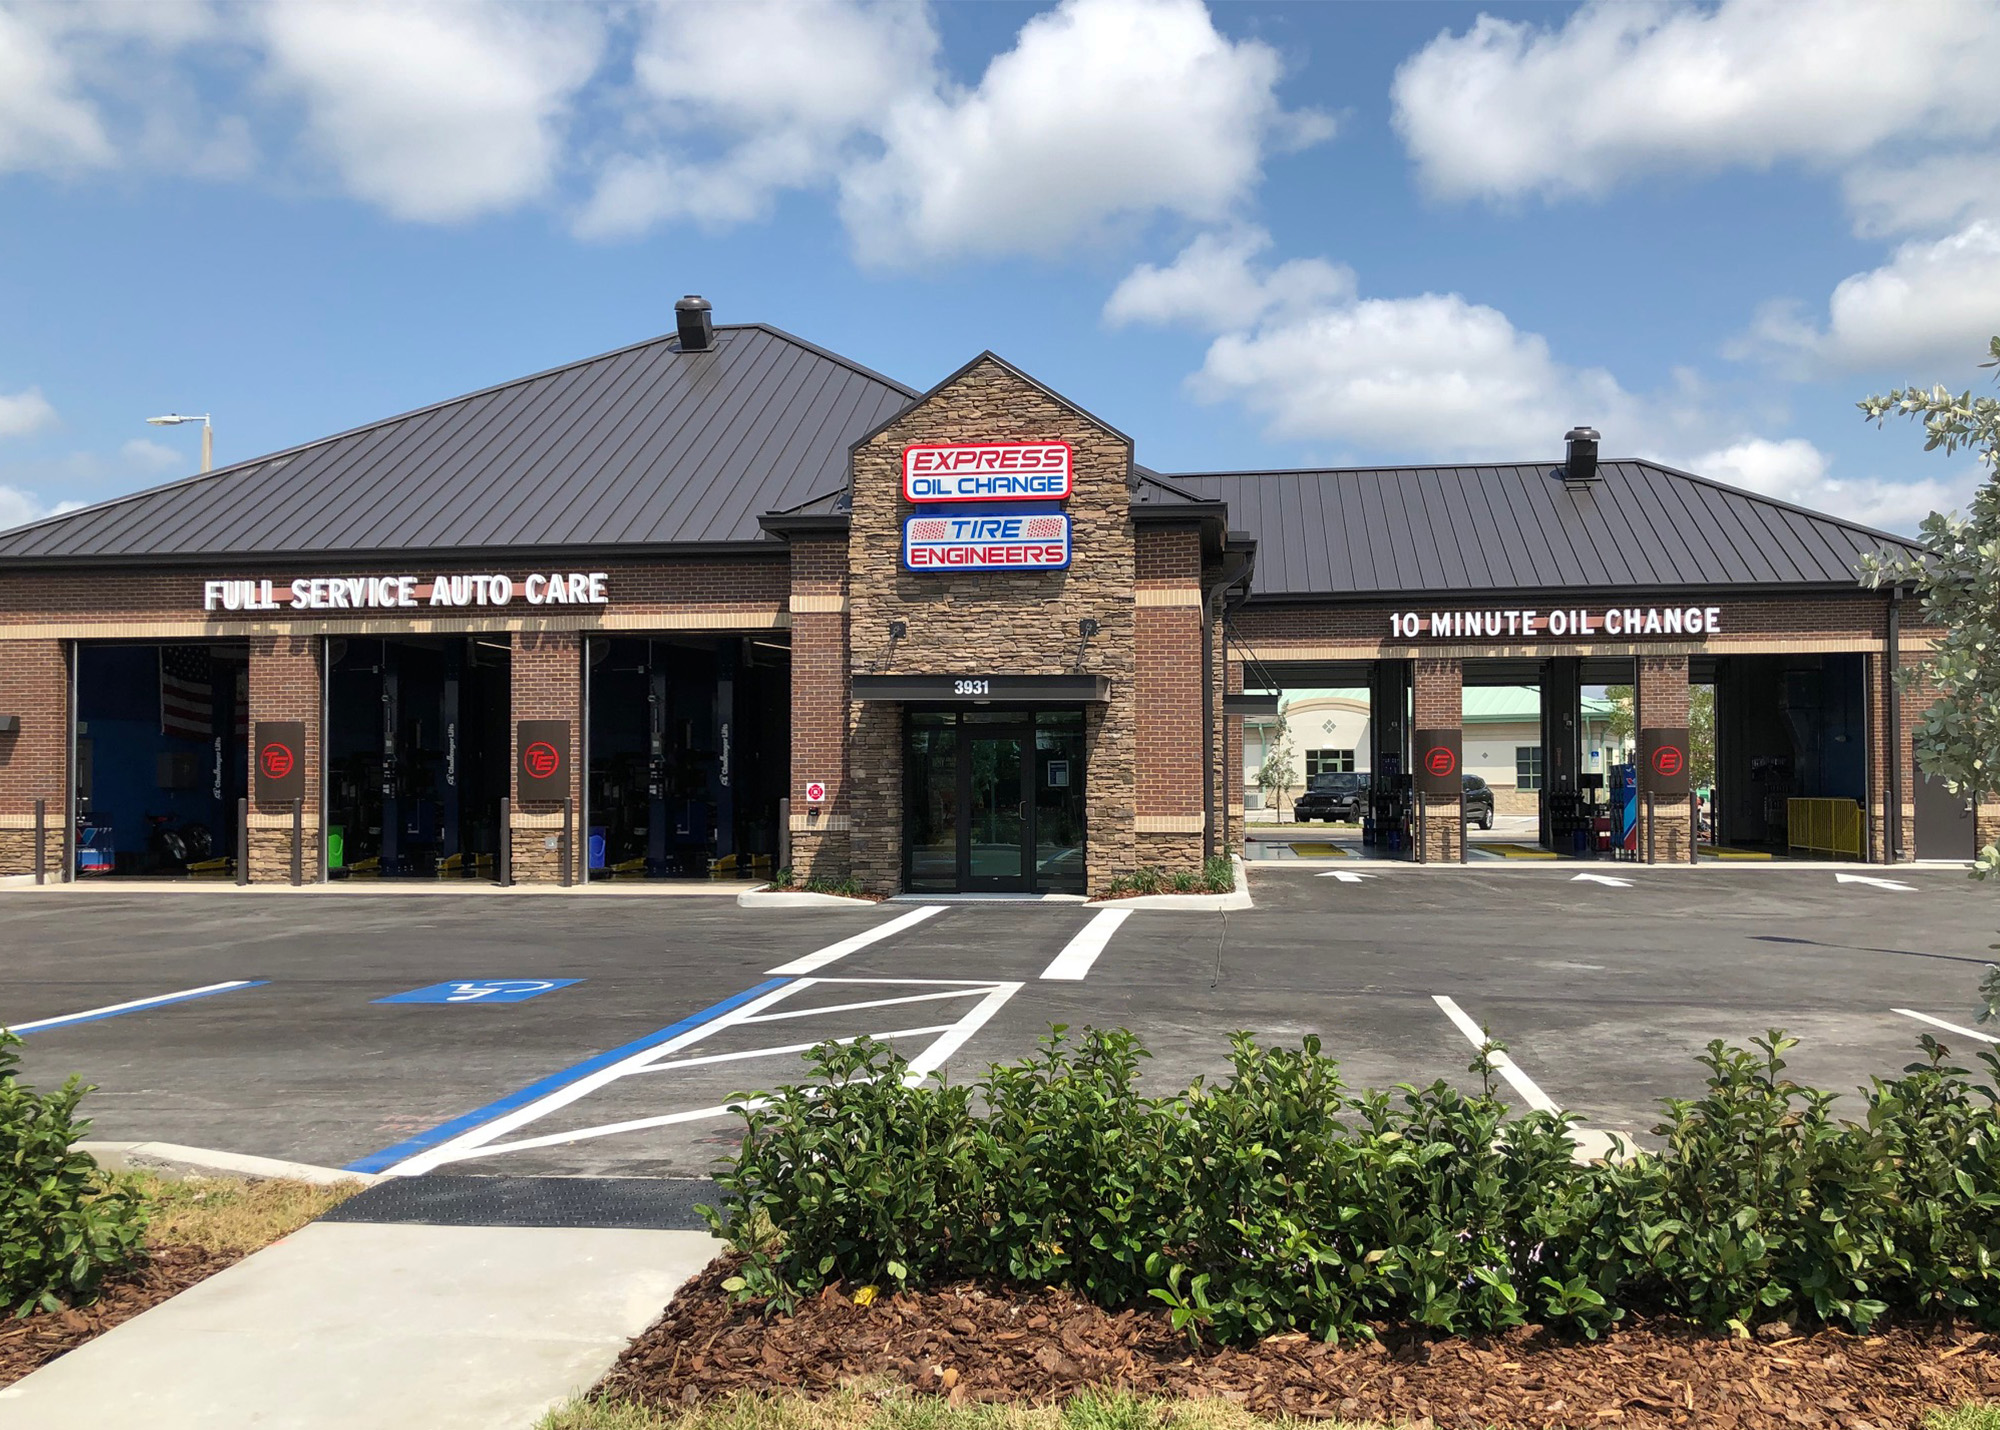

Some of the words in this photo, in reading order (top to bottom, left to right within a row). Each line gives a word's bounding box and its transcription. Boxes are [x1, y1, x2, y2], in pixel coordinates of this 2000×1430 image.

[912, 448, 1066, 471] EXPRESS
[912, 478, 953, 496] OIL
[957, 476, 1064, 494] CHANGE
[951, 519, 1023, 539] TIRE
[910, 545, 1064, 565] ENGINEERS
[204, 580, 281, 611] FULL
[290, 576, 419, 609] SERVICE
[429, 574, 513, 606] AUTO
[525, 572, 609, 604] CARE
[1389, 612, 1420, 638] 10
[1431, 610, 1538, 637] MINUTE
[1548, 609, 1595, 636] OIL
[1604, 607, 1721, 634] CHANGE
[954, 680, 989, 694] 3931
[264, 751, 289, 771] TE
[446, 737, 456, 774] Challenger
[529, 751, 554, 771] TE
[720, 737, 730, 775] Challenger
[1432, 754, 1450, 769] E
[1660, 753, 1678, 769] E
[213, 751, 223, 788] Challenger
